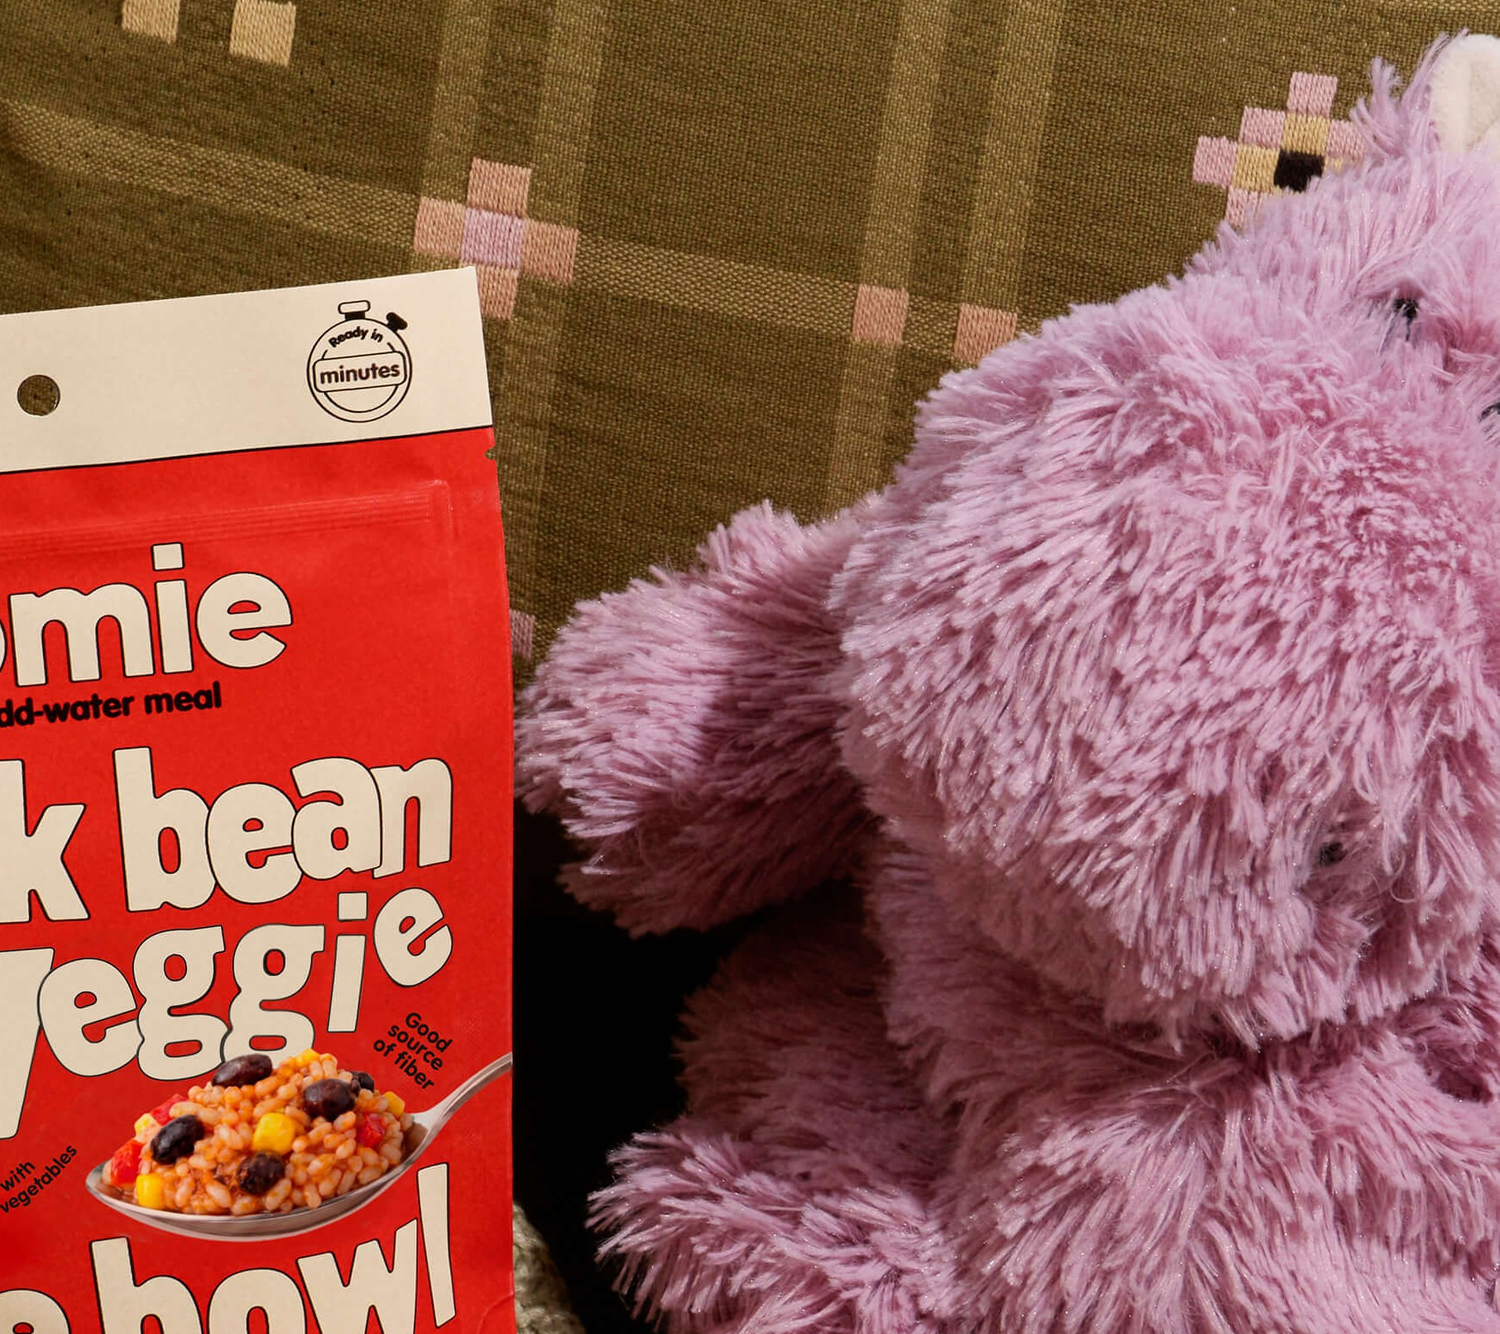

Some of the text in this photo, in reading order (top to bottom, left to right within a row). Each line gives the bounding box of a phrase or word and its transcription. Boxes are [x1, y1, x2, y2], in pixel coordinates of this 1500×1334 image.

[328, 326, 384, 348] Ready in
[320, 363, 400, 384] minutes
[150, 683, 222, 717] meal
[113, 746, 453, 913] bean
[387, 1025, 443, 1071] source
[405, 1012, 453, 1053] Good
[373, 1039, 434, 1089] of fiber
[0, 1161, 36, 1191] with
[0, 1145, 77, 1213] vegetables
